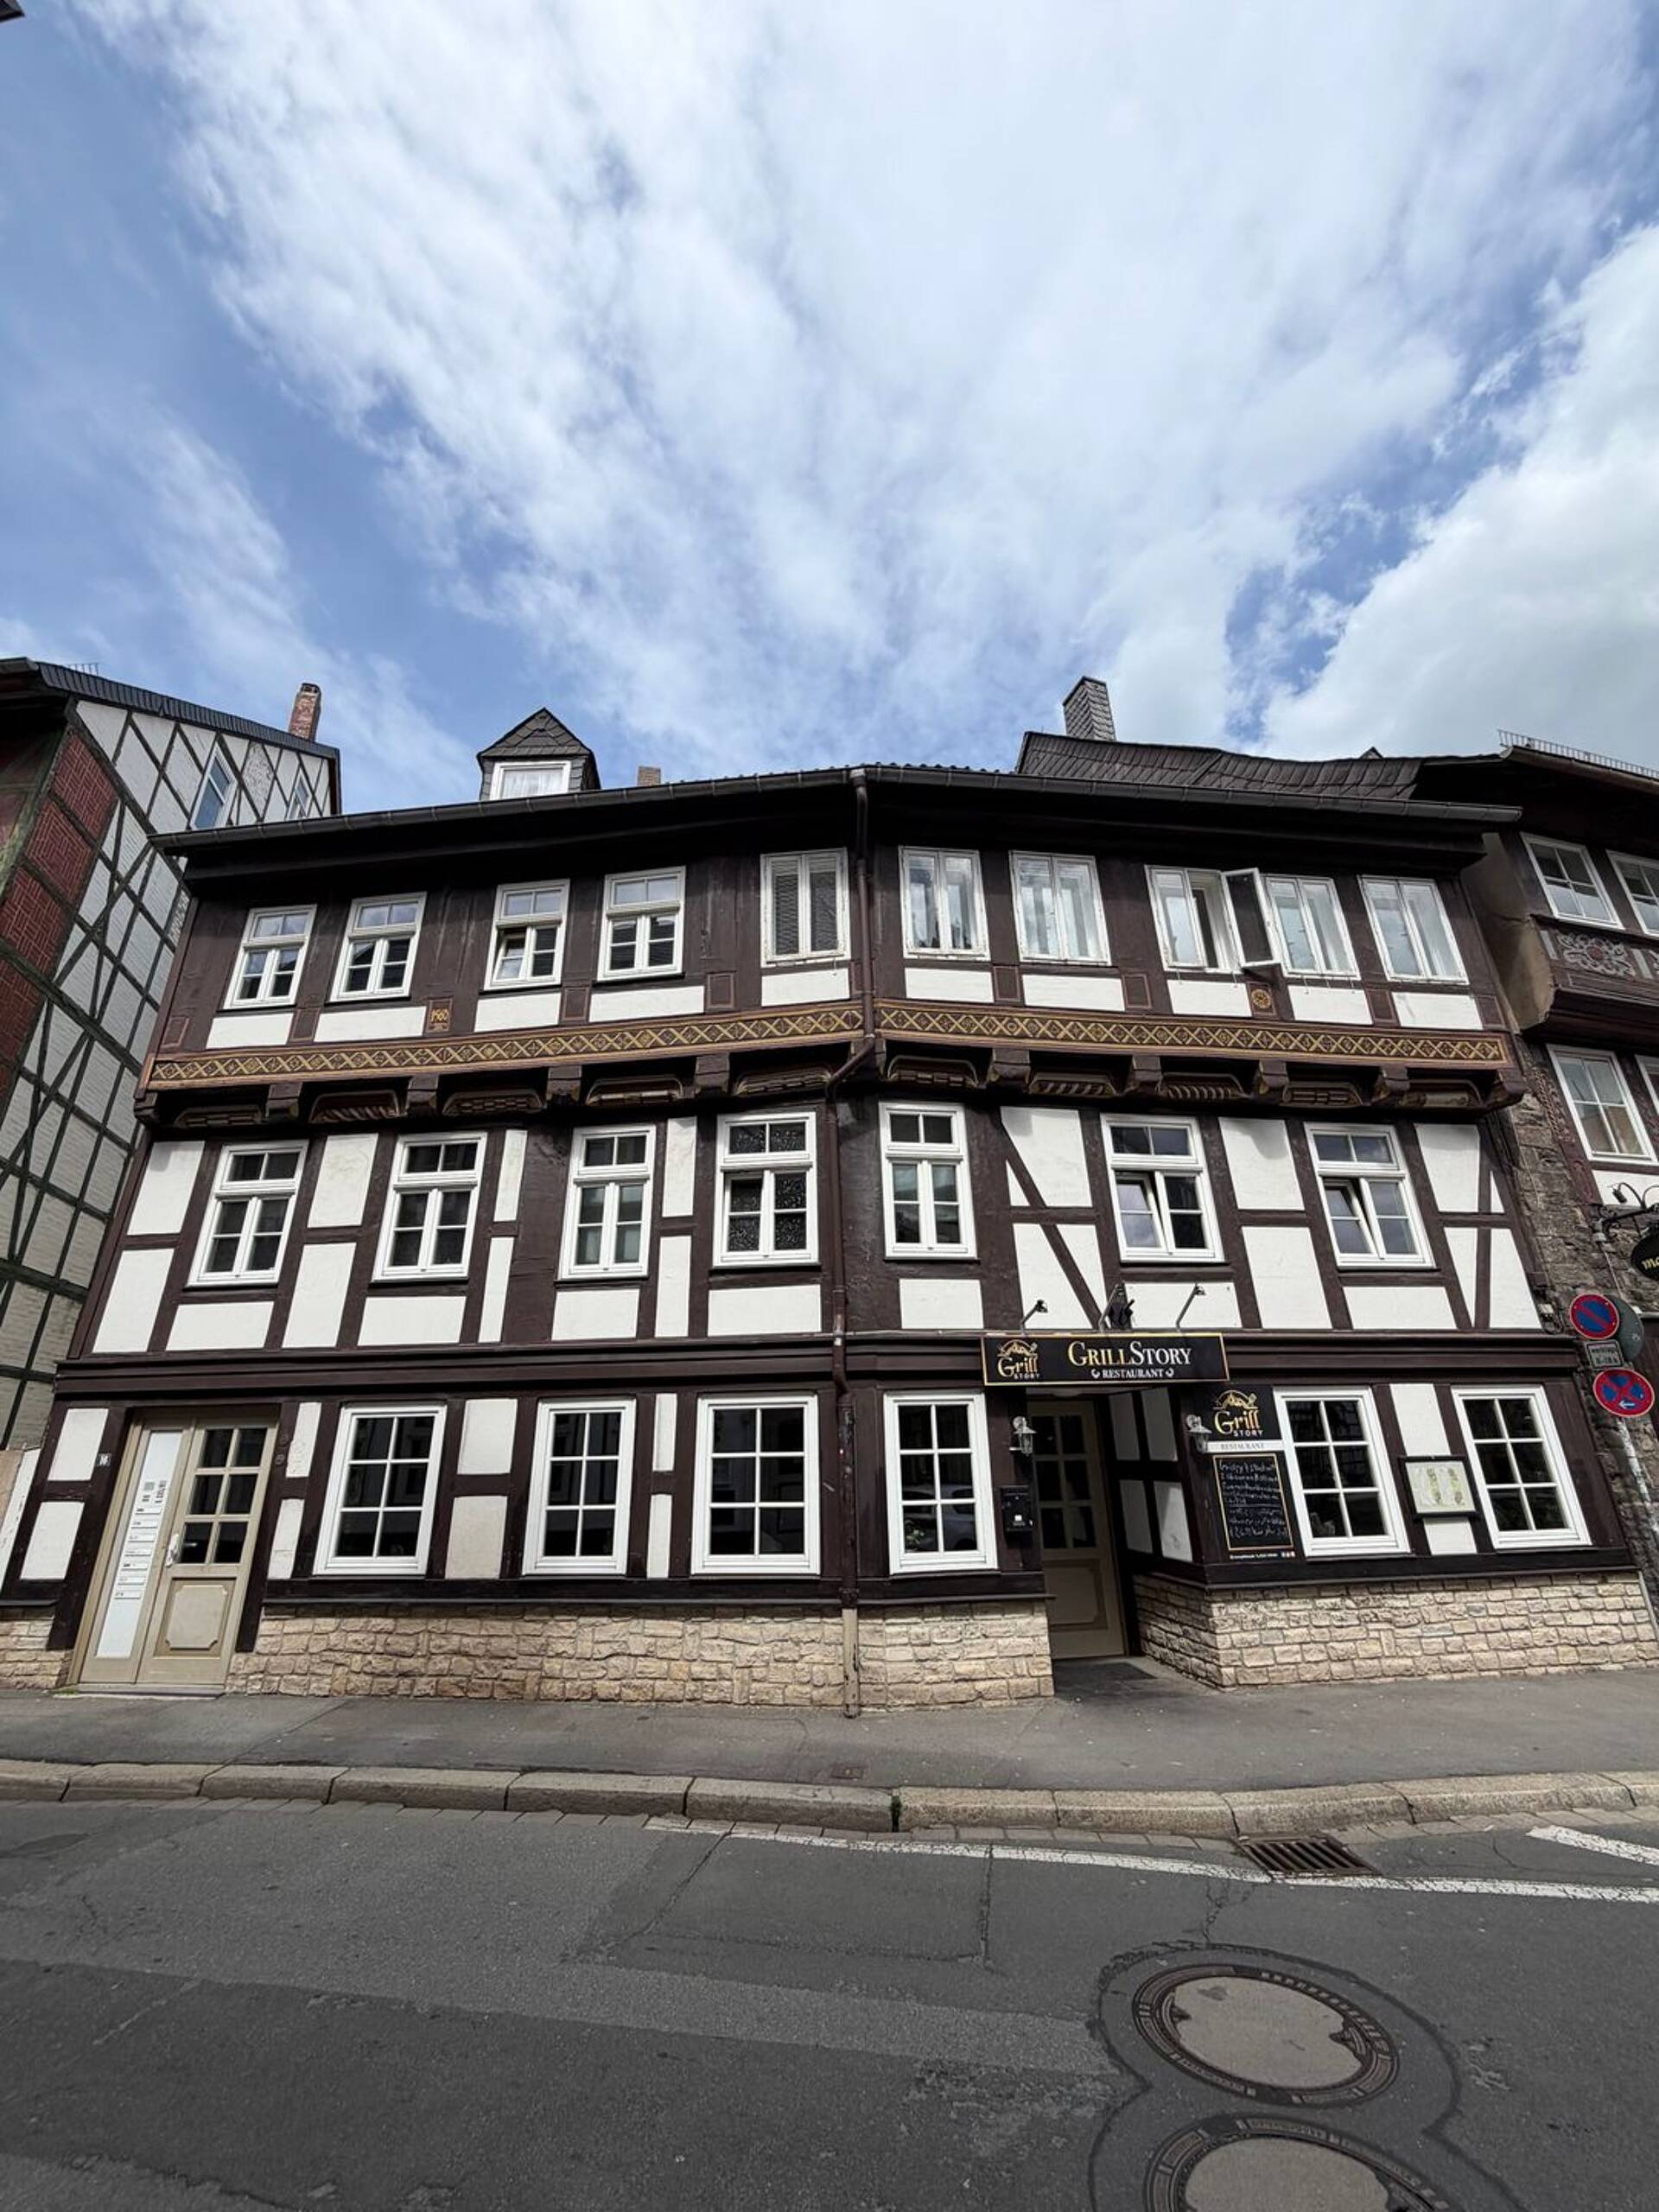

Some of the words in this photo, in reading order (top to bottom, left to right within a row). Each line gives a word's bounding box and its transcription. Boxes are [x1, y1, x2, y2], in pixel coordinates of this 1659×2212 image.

[997, 1357, 1038, 1377] Grill
[1103, 1369, 1164, 1378] RESTAURANT
[1214, 1409, 1260, 1435] Grill
